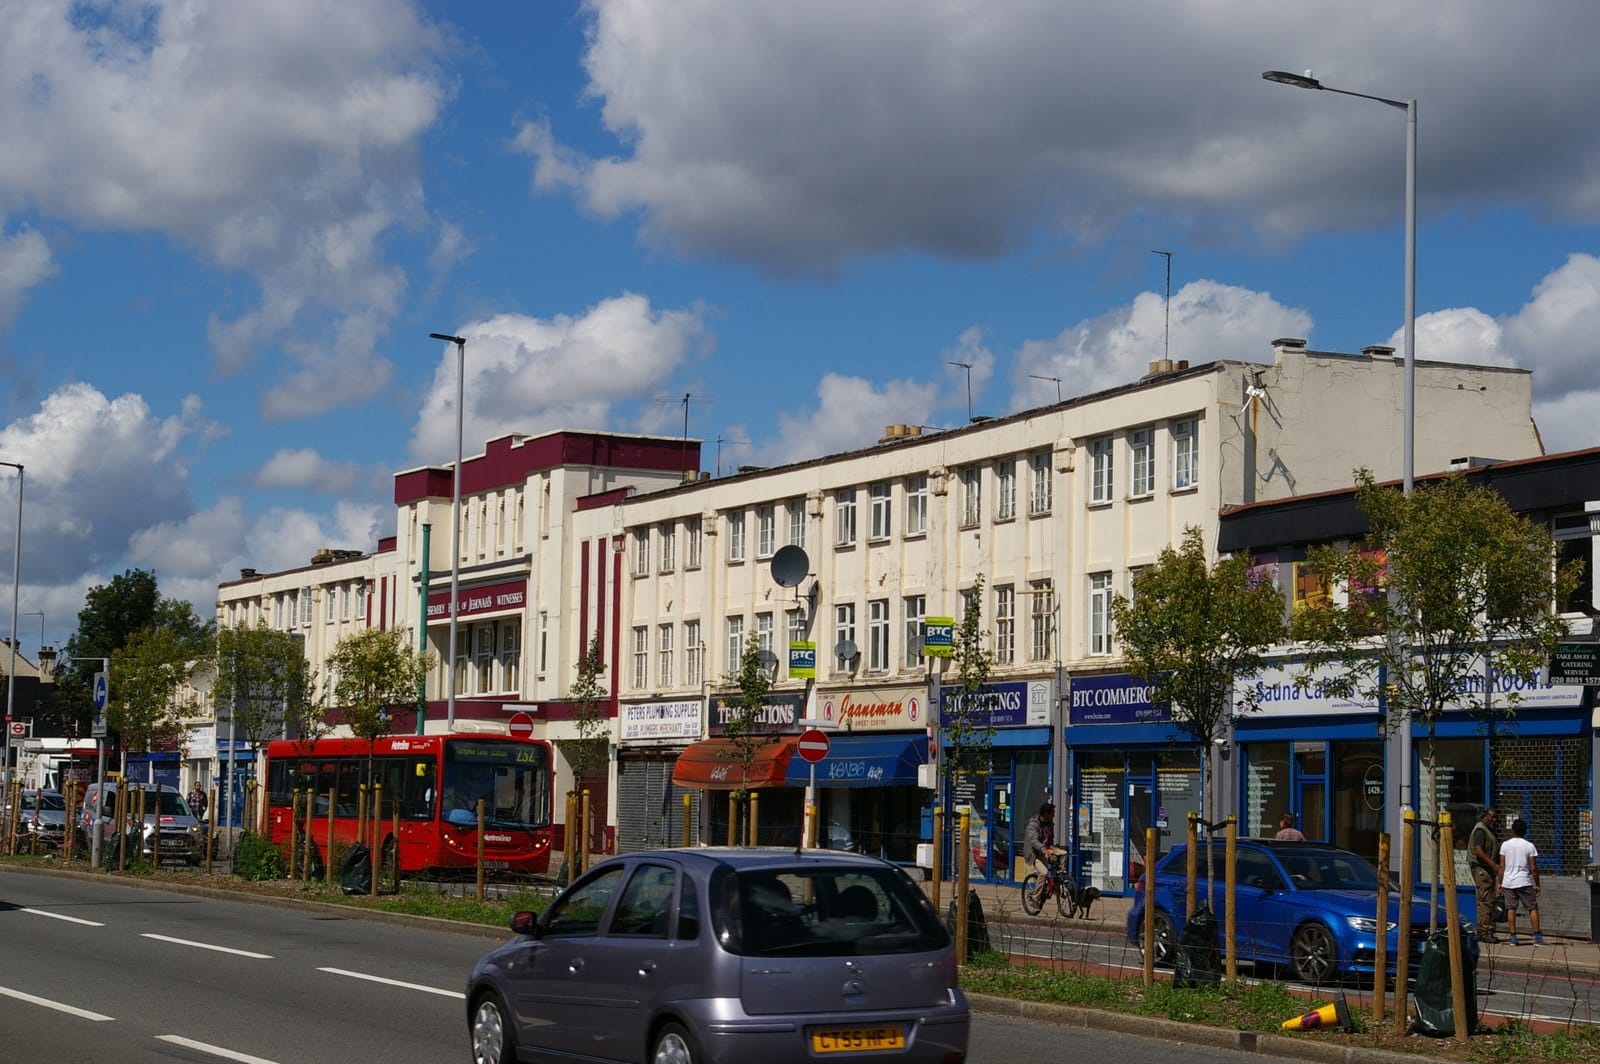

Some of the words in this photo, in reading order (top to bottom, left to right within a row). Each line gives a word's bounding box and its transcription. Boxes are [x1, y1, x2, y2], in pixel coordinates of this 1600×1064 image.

[497, 592, 523, 605] WITNESSES
[927, 626, 951, 637] BTC
[791, 650, 814, 661] BTC
[1031, 692, 1047, 704] BTC
[1256, 681, 1300, 703] Sauna
[1073, 690, 1093, 708] BTC
[627, 706, 646, 721] PETERS
[674, 703, 698, 718] SUPPLIES
[839, 693, 903, 725] Jaaneman
[516, 749, 536, 762] 232
